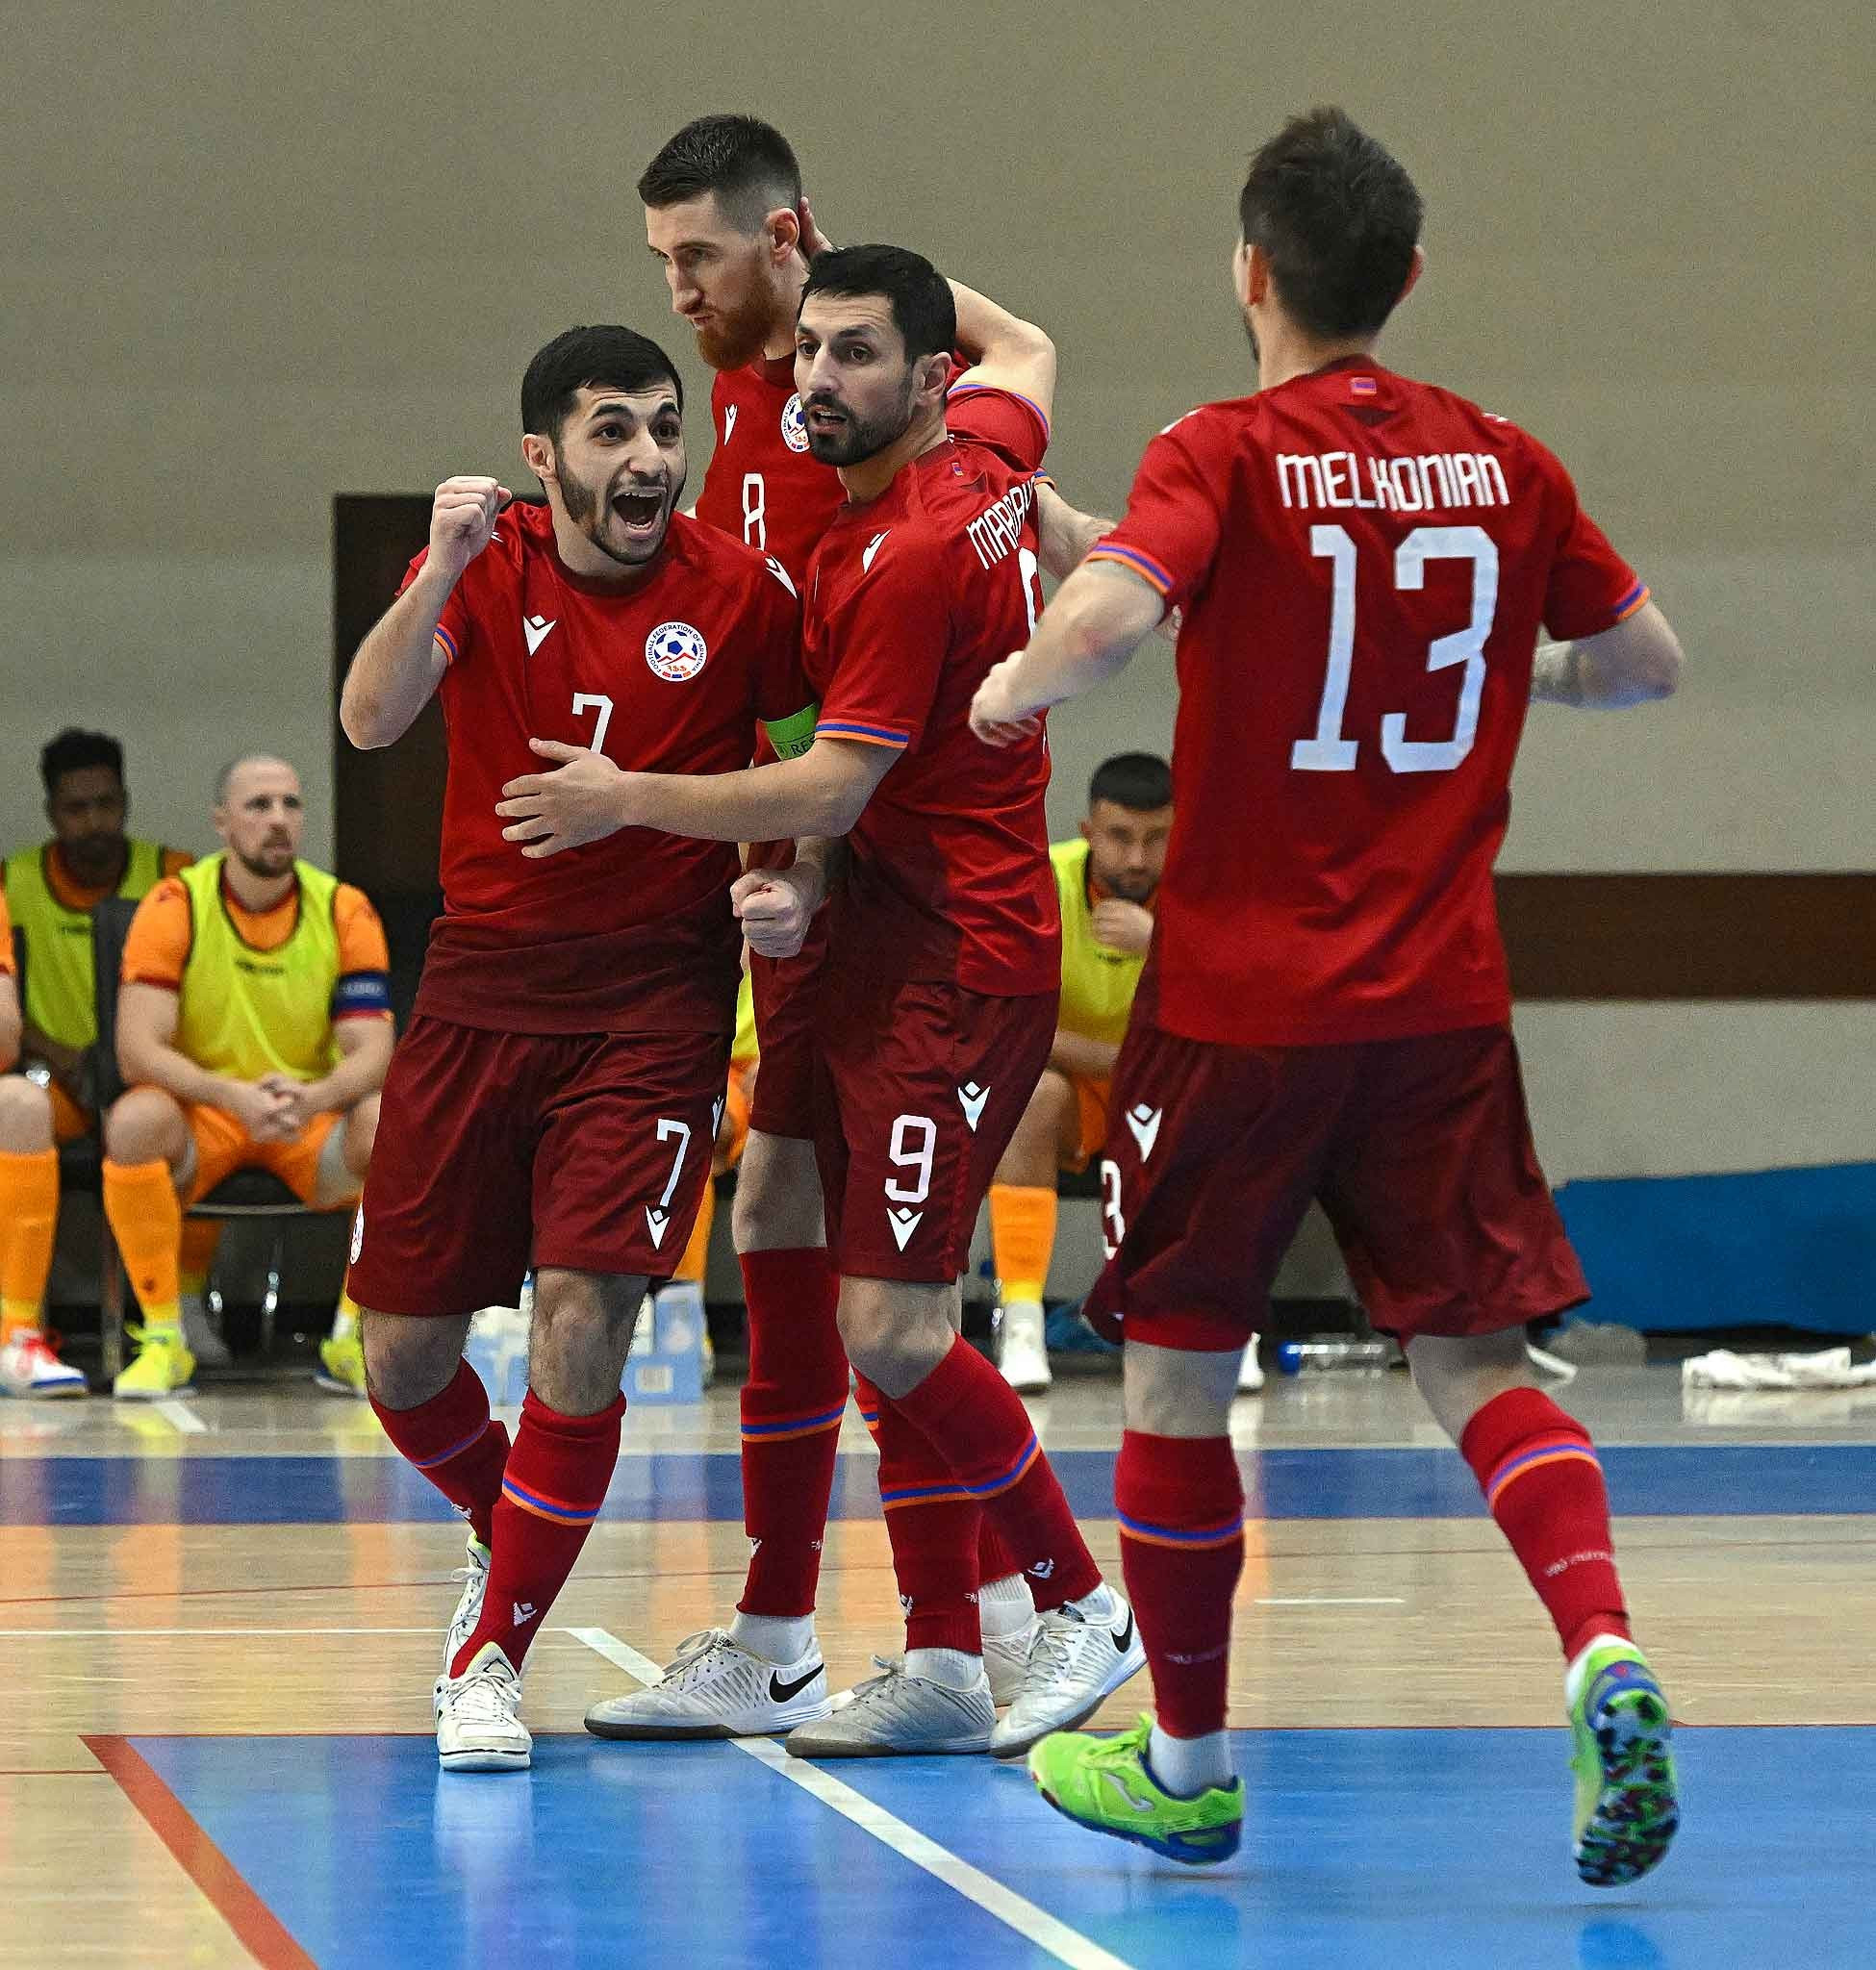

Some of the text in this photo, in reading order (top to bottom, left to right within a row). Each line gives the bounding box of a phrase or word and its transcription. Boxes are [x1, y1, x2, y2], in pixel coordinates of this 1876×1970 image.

[743, 473, 766, 551] 8
[1276, 452, 1510, 512] MELKONIAN
[653, 625, 693, 640] FEDERATION
[693, 633, 702, 642] OF
[1290, 524, 1499, 773] 13
[572, 693, 614, 754] 7
[656, 1119, 691, 1207] 7
[885, 1115, 937, 1202] 9
